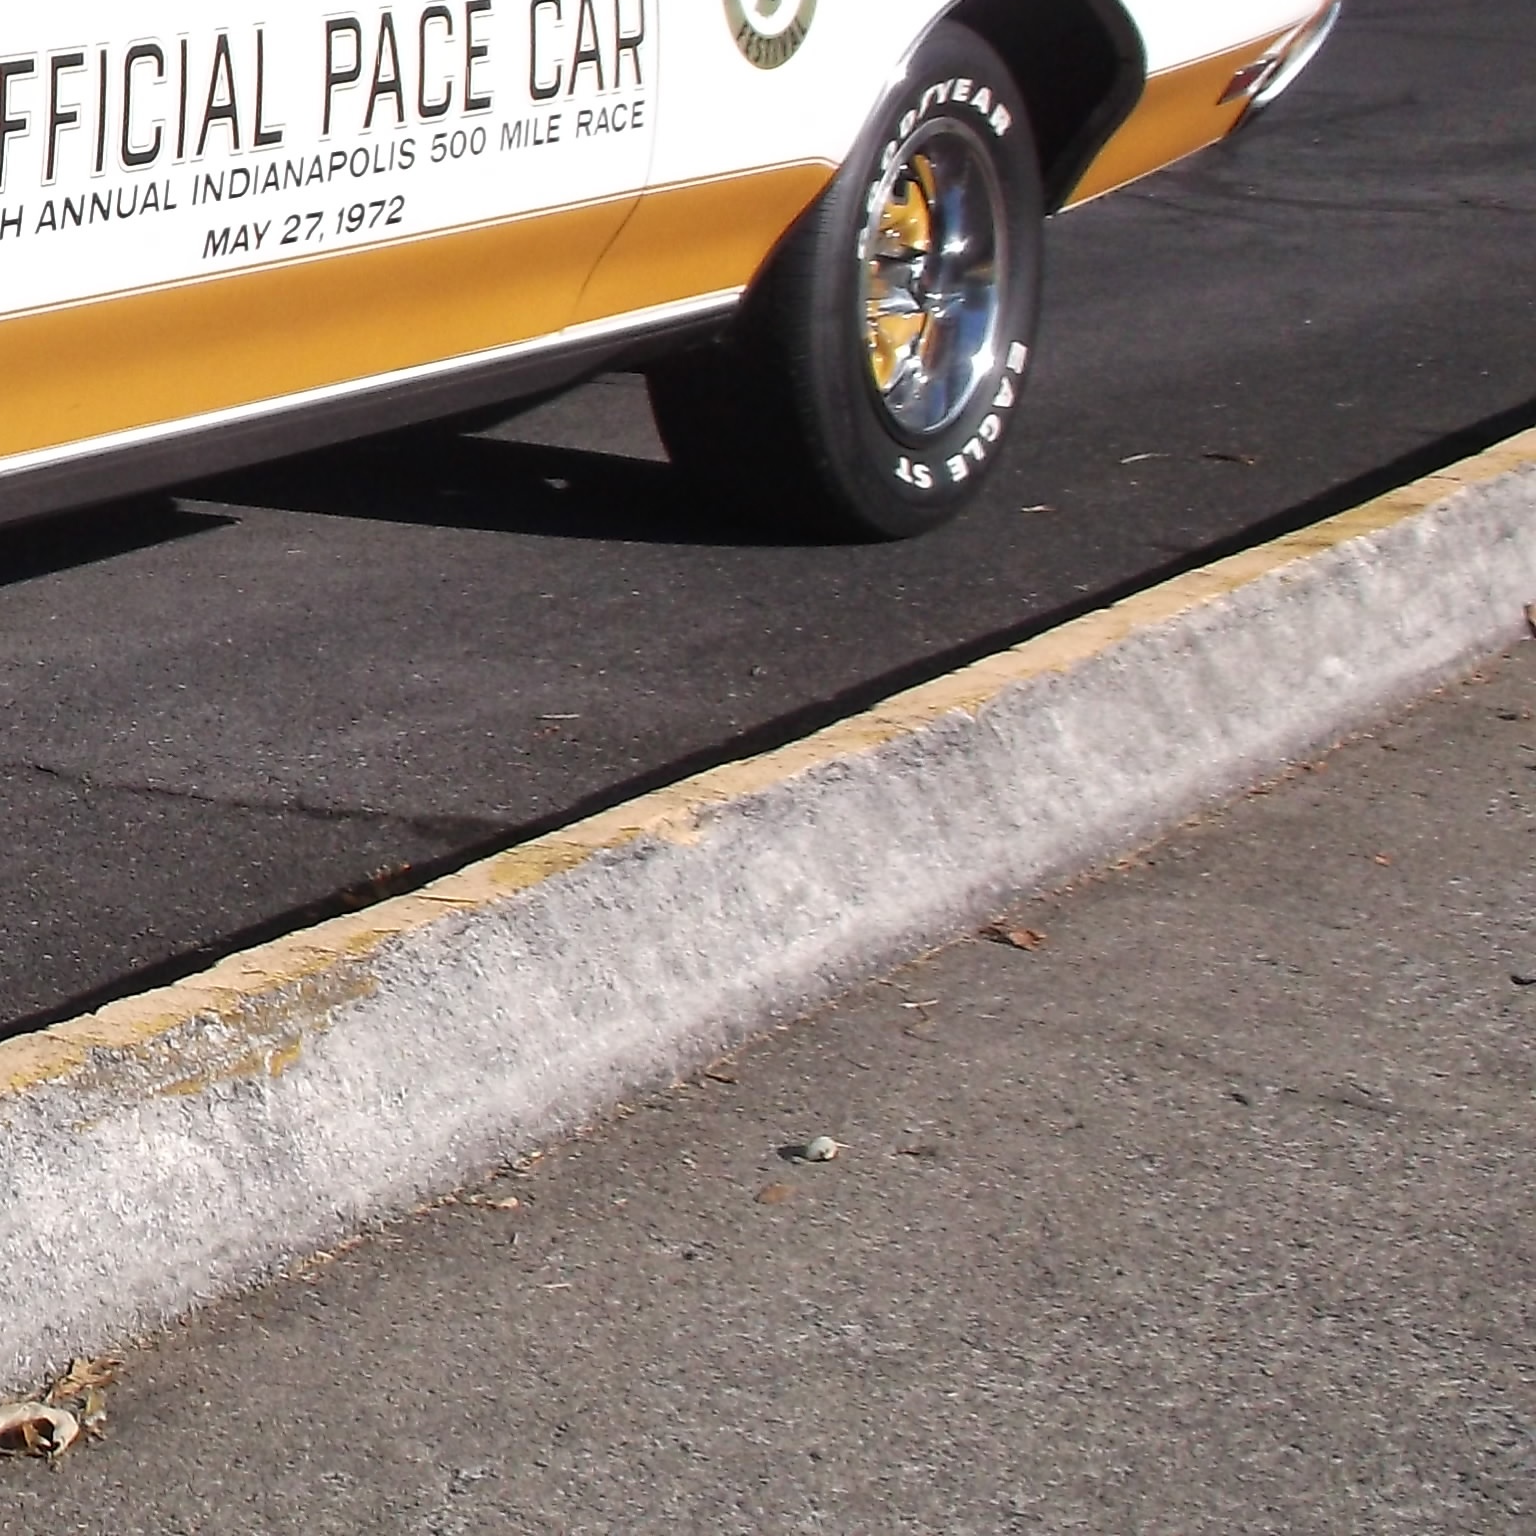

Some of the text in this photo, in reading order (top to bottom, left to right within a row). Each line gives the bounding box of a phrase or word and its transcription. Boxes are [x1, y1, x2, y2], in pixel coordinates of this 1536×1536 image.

[35, 179, 177, 235] ANNUAL
[192, 138, 416, 206] INDIANAPOLIS
[430, 126, 487, 164] 500
[500, 113, 562, 152] MILE
[576, 100, 645, 139] RACE
[202, 219, 272, 260] MAY
[895, 340, 1028, 489] EAGLE ST
